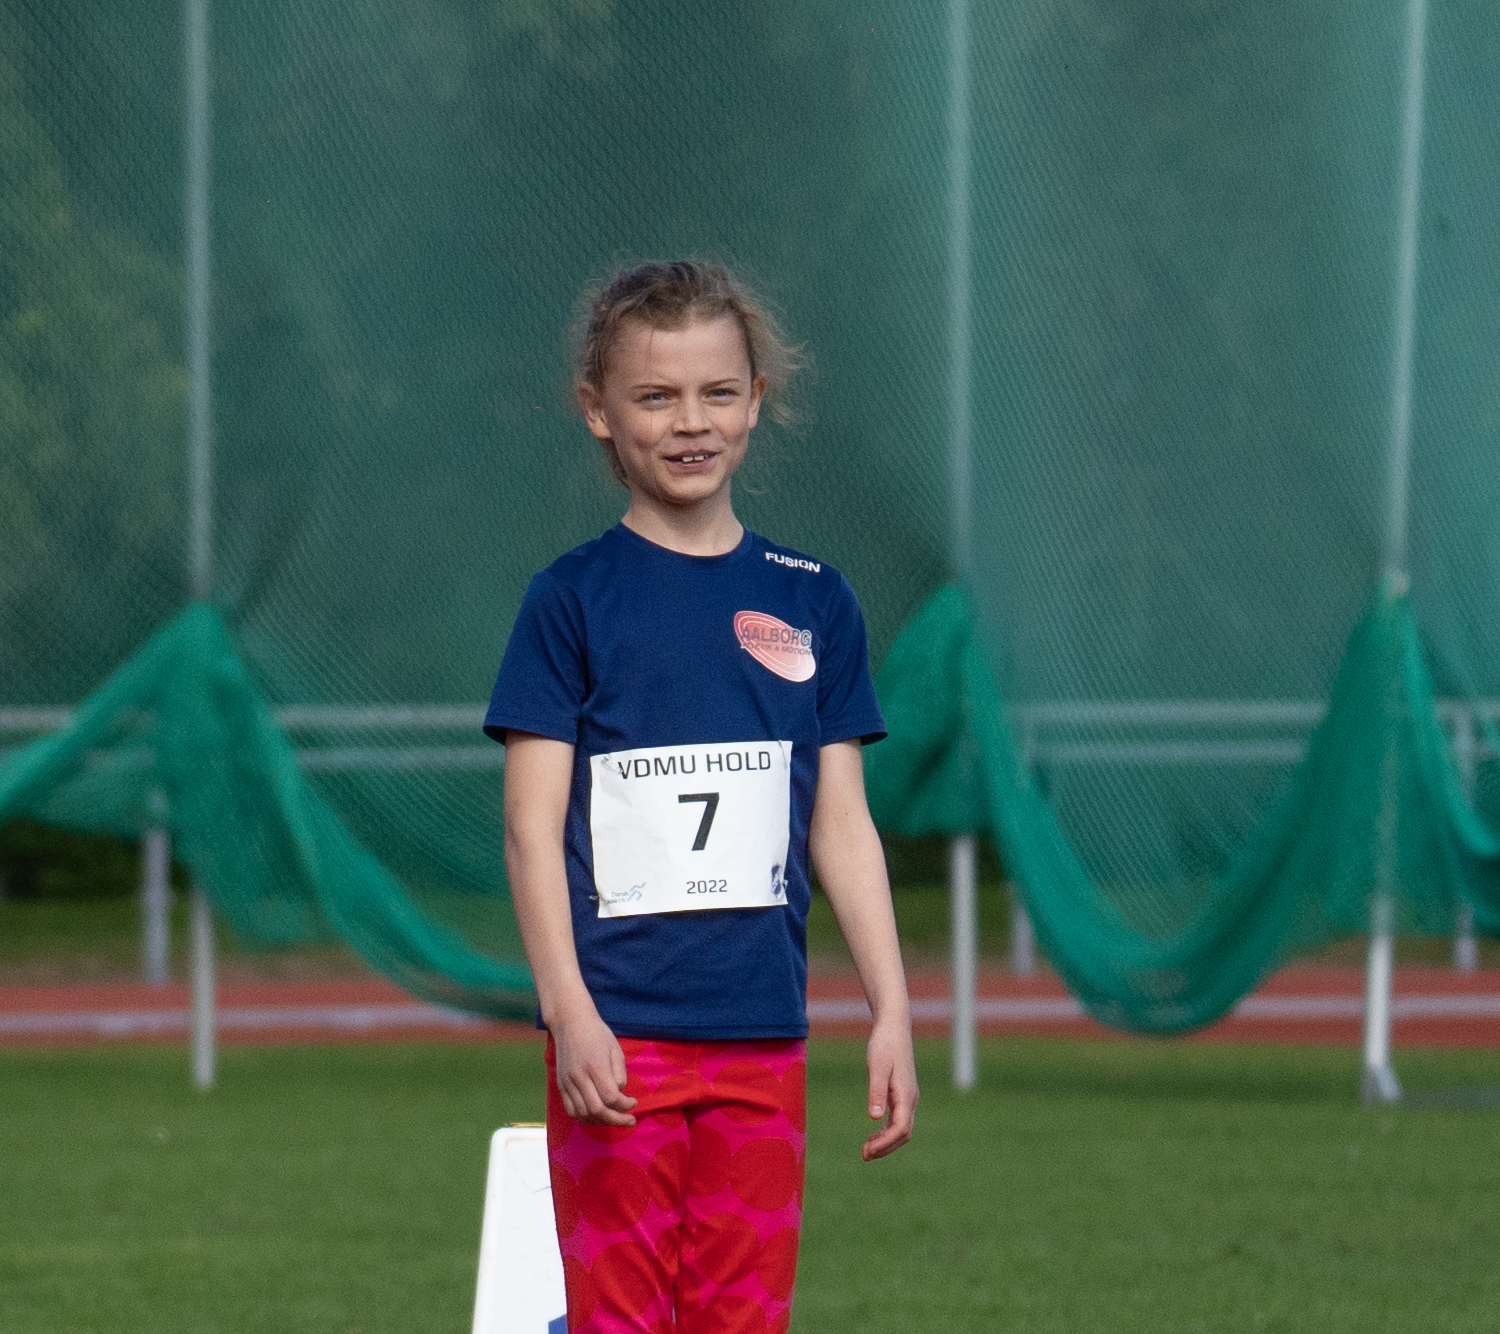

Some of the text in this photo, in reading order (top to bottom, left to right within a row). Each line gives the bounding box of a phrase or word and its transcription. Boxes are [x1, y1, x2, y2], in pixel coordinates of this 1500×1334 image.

[764, 552, 821, 573] FUSION
[741, 625, 812, 647] AALBORG
[618, 750, 771, 780] VDMU HOLD
[677, 791, 720, 852] 7
[686, 879, 728, 895] 2022
